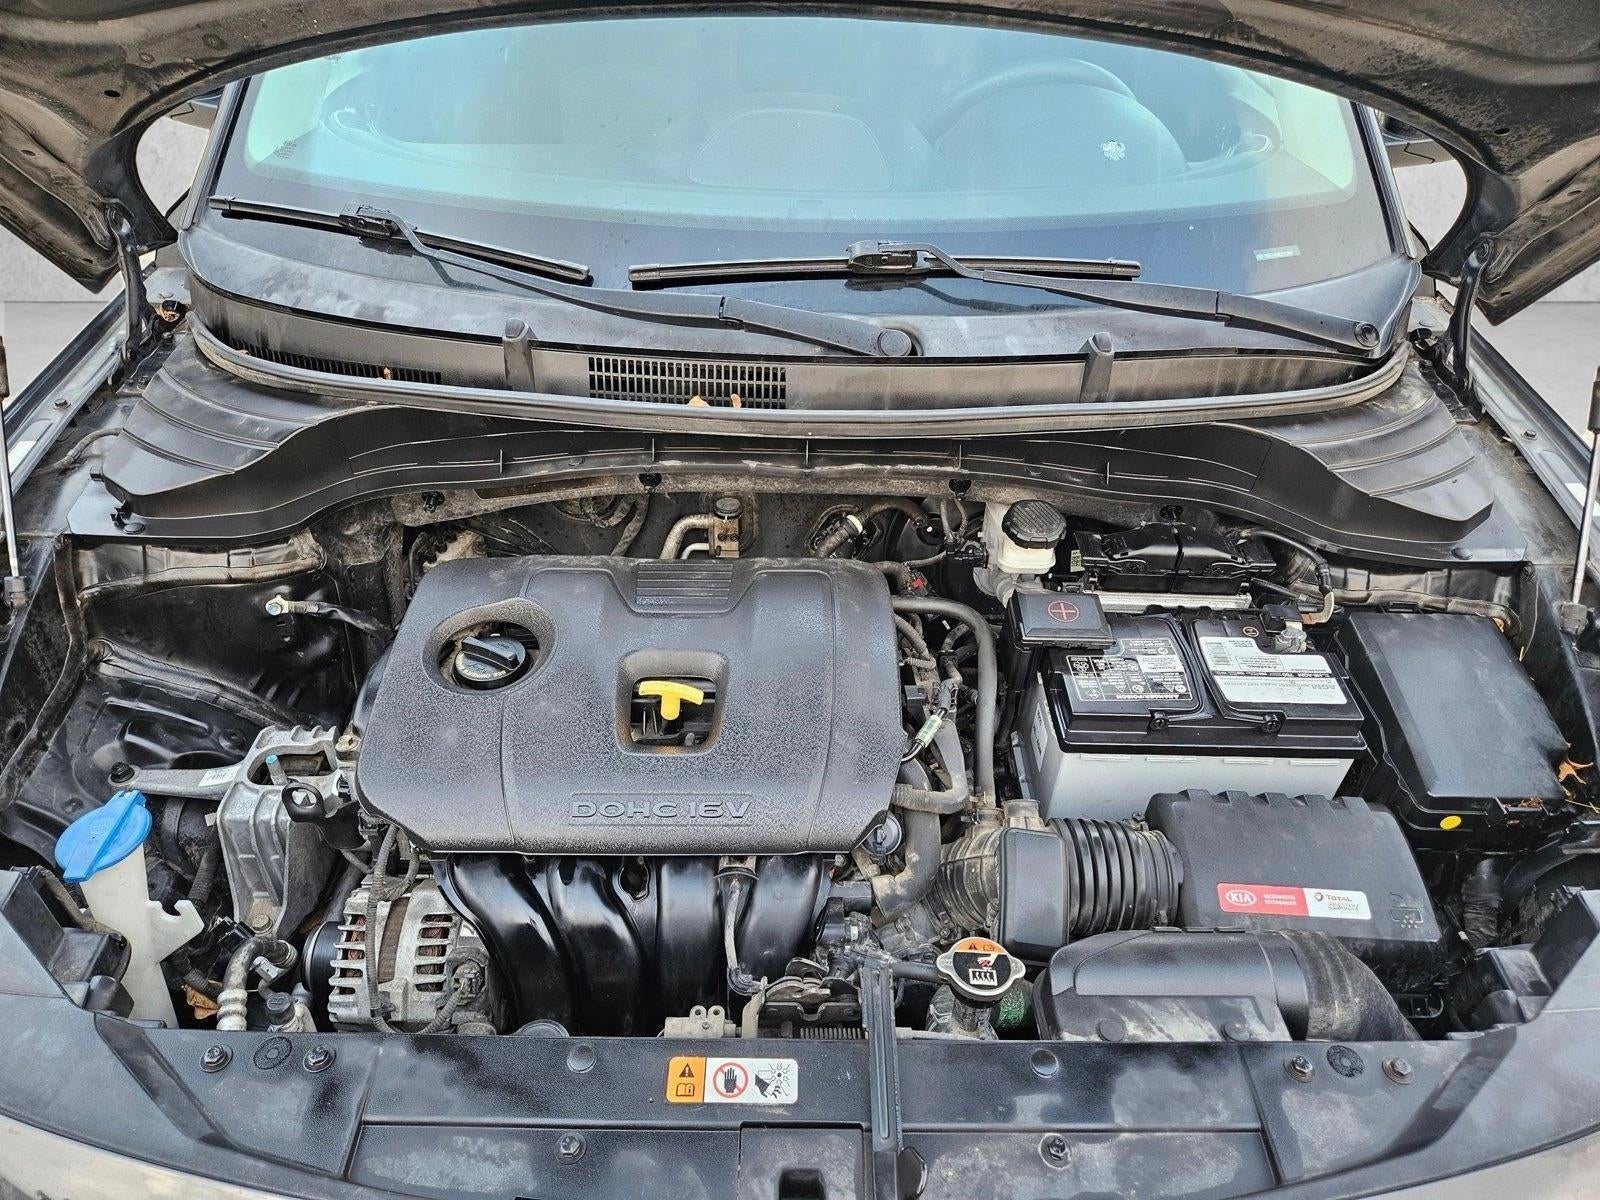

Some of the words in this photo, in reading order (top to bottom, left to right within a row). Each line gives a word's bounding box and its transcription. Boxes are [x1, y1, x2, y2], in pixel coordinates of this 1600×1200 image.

[571, 801, 677, 818] DOHC
[688, 801, 752, 818] 16V
[1229, 892, 1253, 904] KIA
